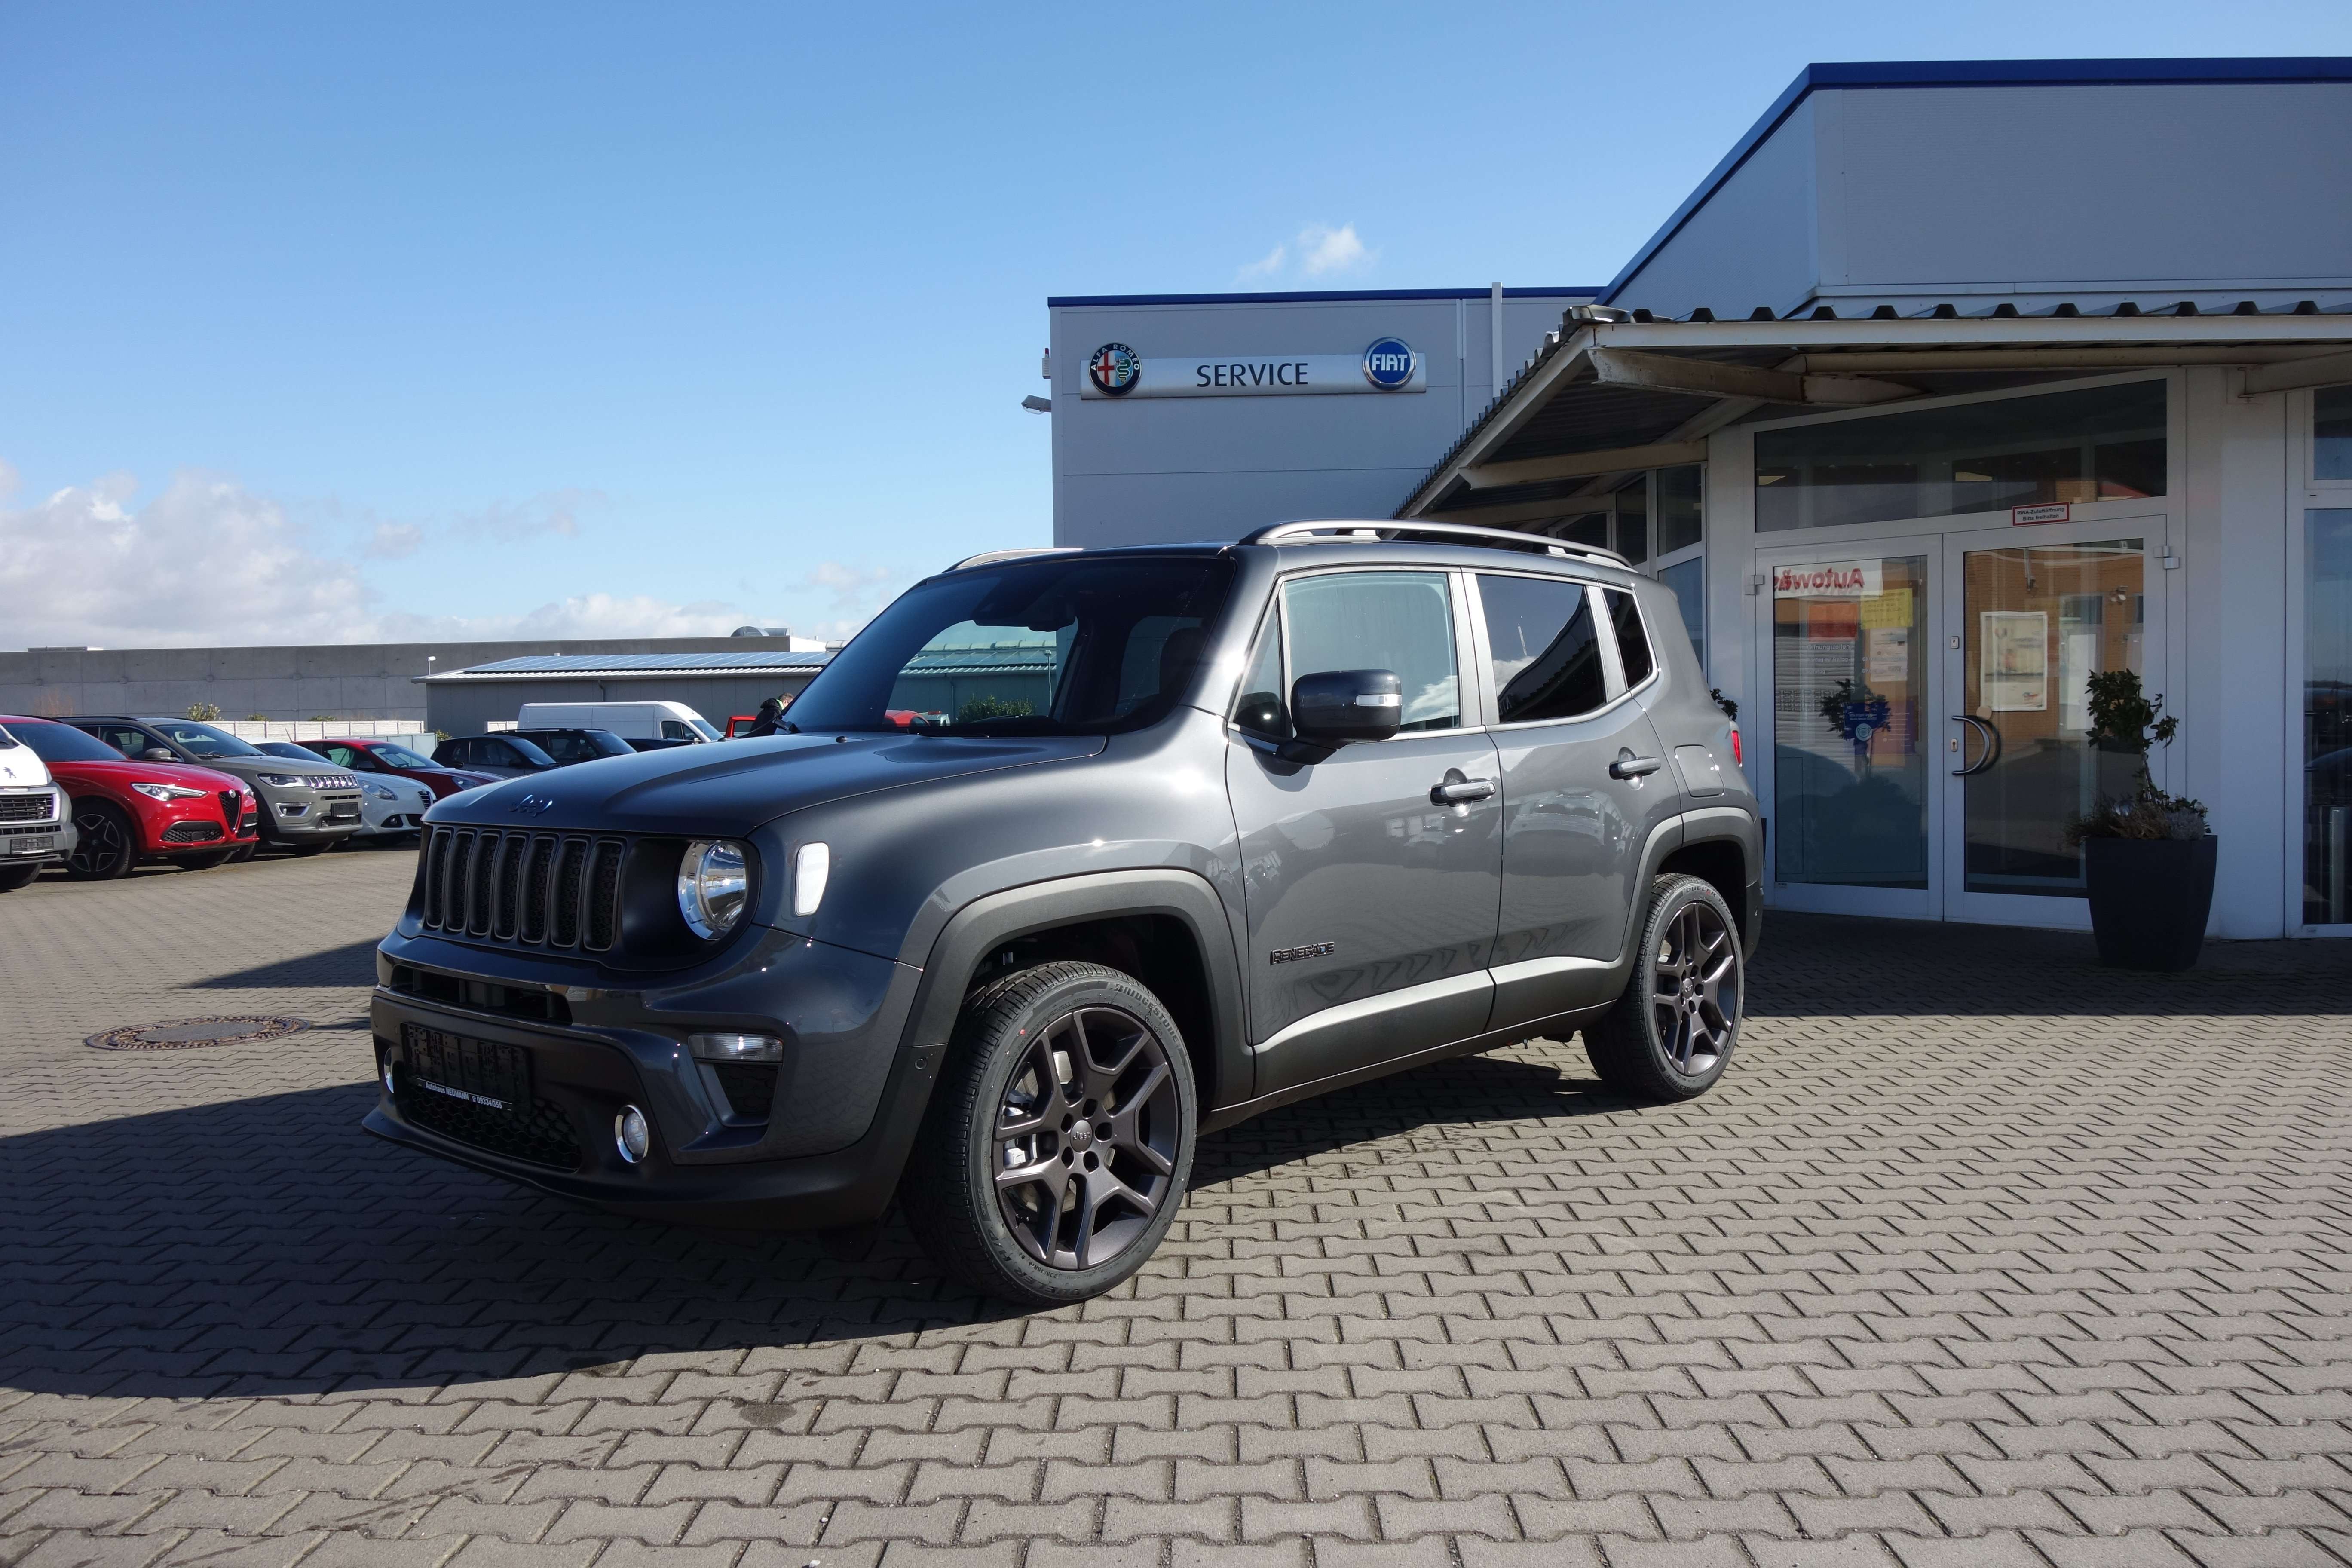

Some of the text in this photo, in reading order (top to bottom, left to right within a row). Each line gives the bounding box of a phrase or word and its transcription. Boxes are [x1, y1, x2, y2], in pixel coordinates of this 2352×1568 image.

[1091, 344, 1140, 371] ALFA ROMEO
[1372, 354, 1408, 371] FIAT
[1197, 363, 1308, 387] SERVICE
[2017, 507, 2065, 515] RWA-Zuluftöffnung
[1686, 886, 1716, 897] DUELER
[1270, 941, 1335, 966] RENEGADE
[1114, 983, 1178, 1043] BRIDGESTONE
[426, 1082, 502, 1109] Autohaus NEUMANN 09334/355
